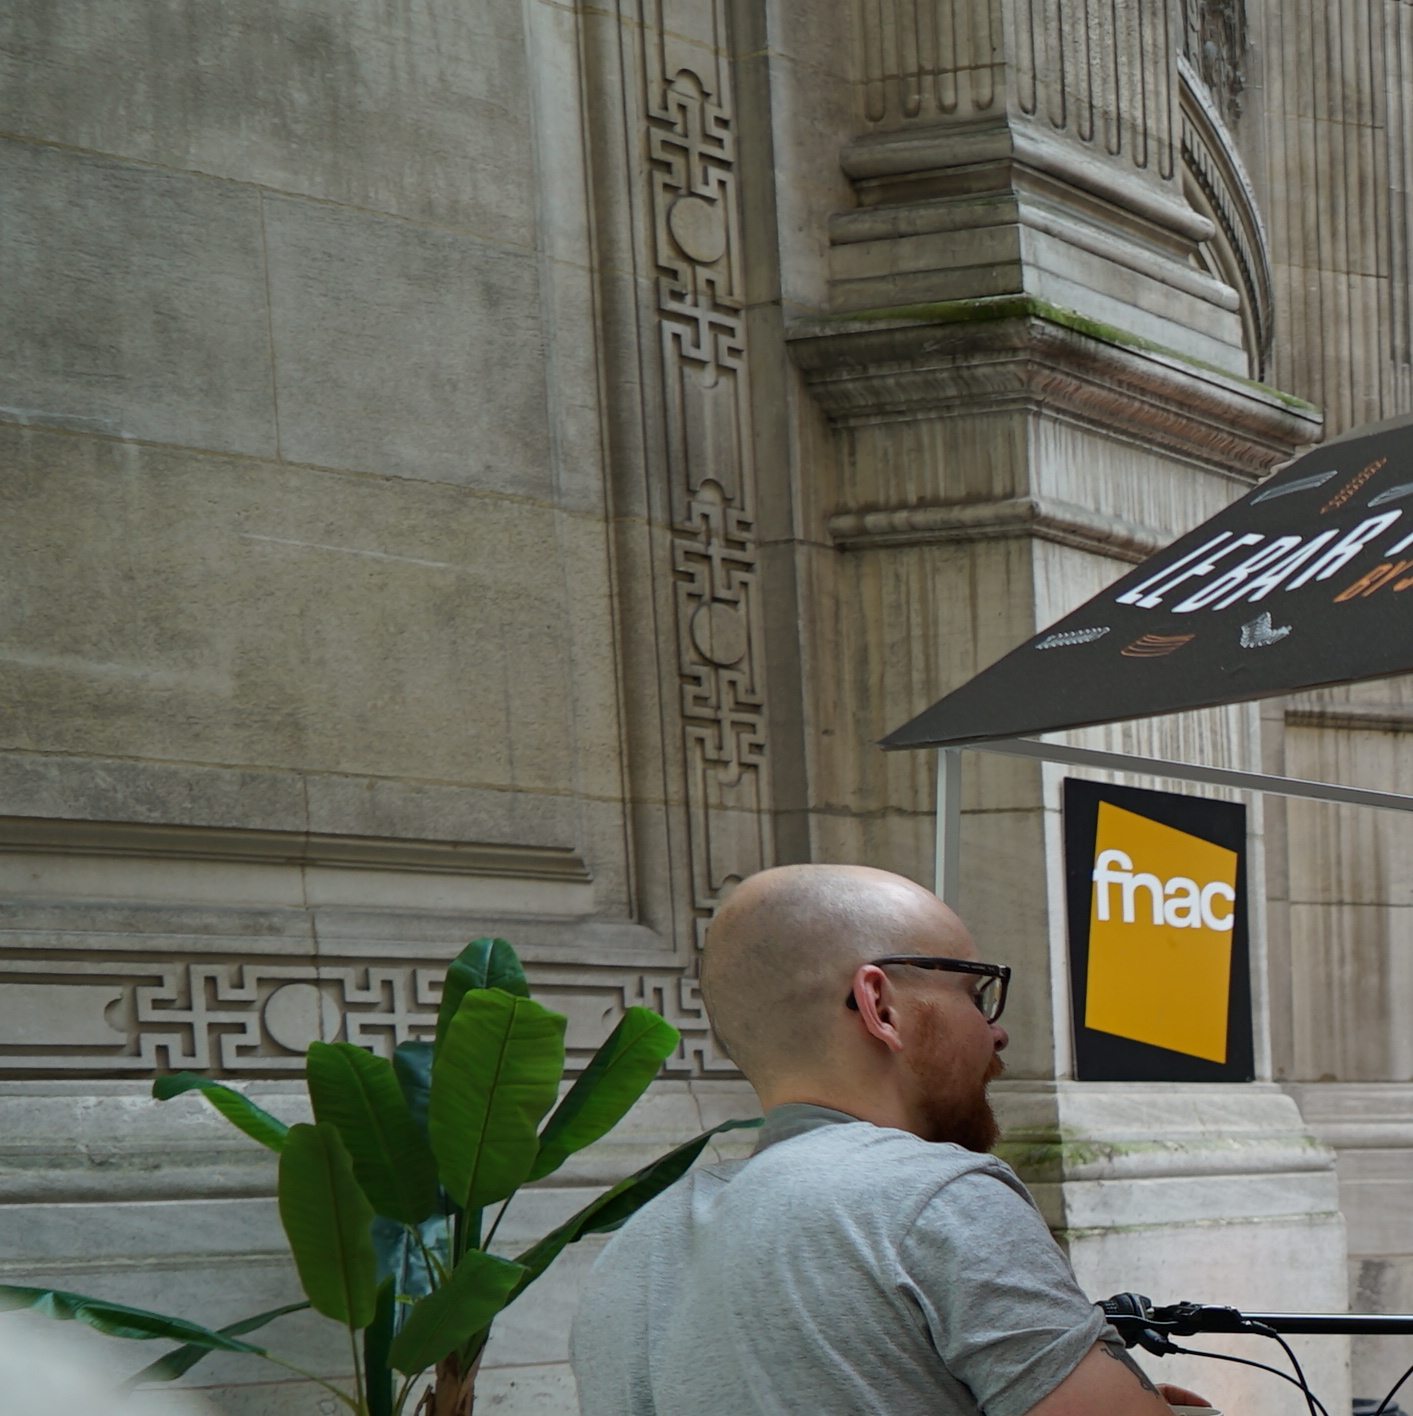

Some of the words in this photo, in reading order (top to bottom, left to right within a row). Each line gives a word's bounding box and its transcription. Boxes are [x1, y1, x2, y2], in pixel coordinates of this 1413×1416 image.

[1115, 530, 1264, 610] LE
[1172, 508, 1402, 613] BAR
[1092, 849, 1236, 932] fnac
